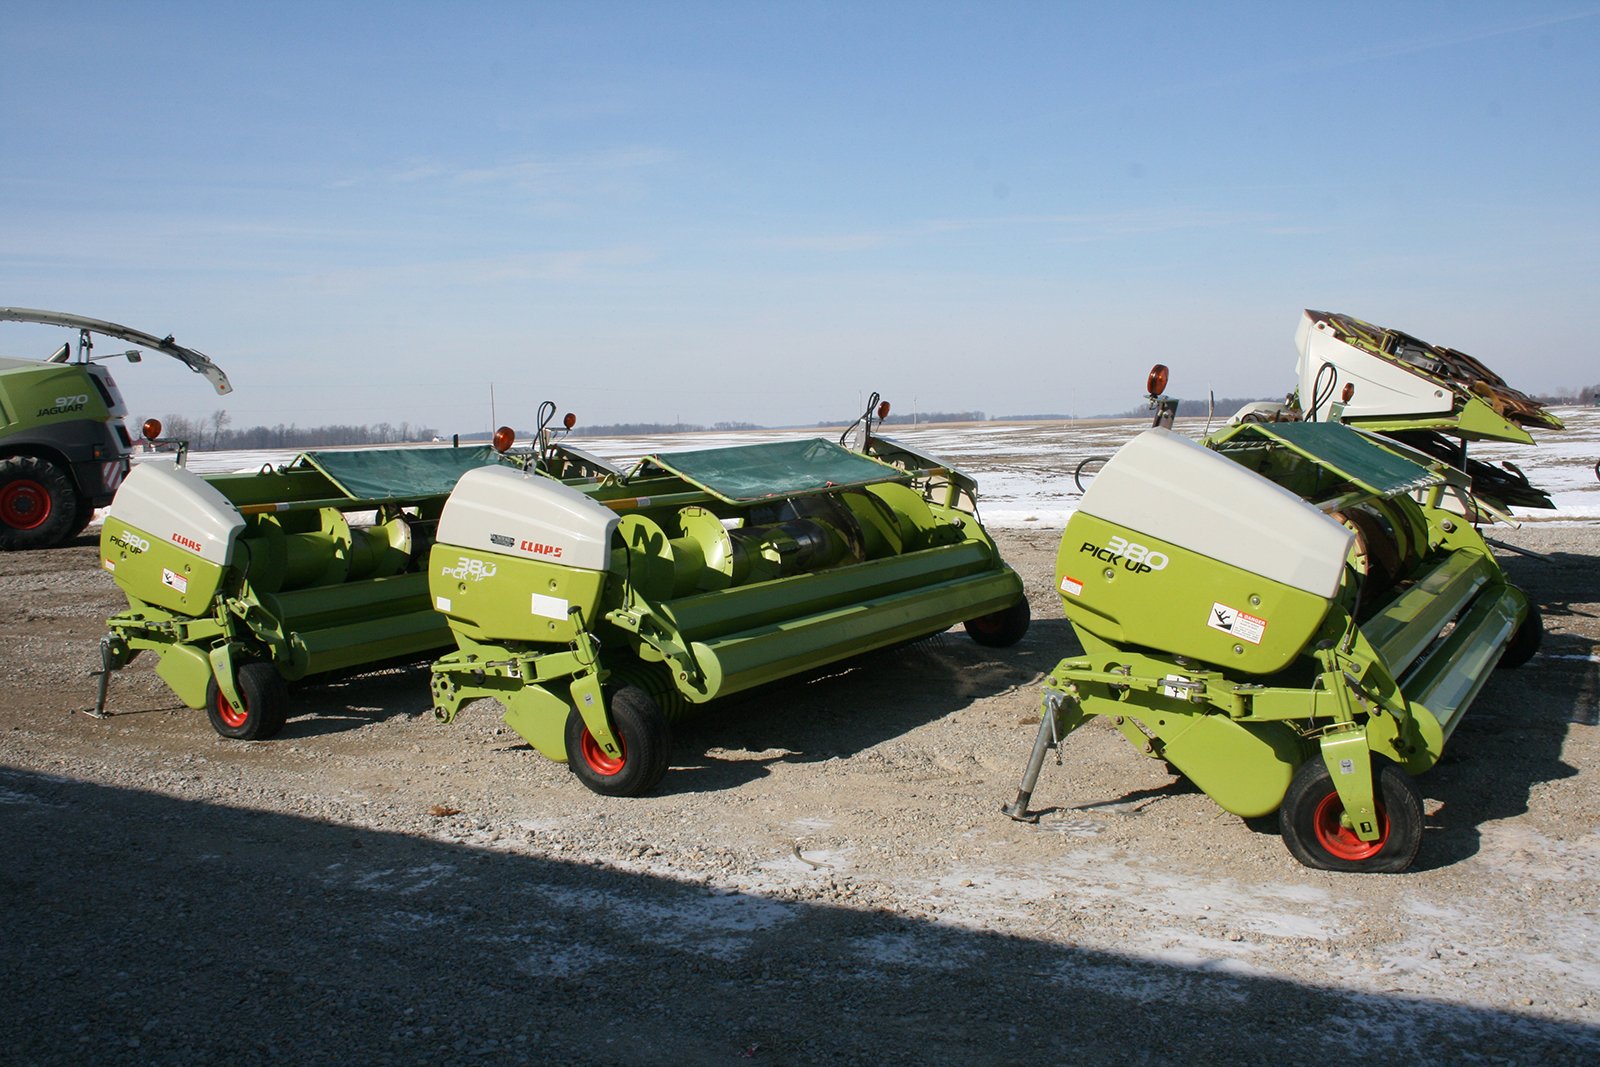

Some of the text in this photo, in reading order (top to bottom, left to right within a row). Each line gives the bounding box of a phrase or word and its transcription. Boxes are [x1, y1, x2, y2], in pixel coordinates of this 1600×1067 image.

[36, 403, 84, 417] JAGUAR
[55, 394, 89, 407] 970
[109, 535, 143, 555] PICK UP
[120, 530, 150, 553] 380
[172, 532, 202, 552] CLAAS
[1079, 542, 1152, 574] PICK UP
[1104, 535, 1169, 571] 380
[441, 566, 469, 581] PICK
[457, 556, 497, 577] 380
[1243, 614, 1266, 626] DANGER
